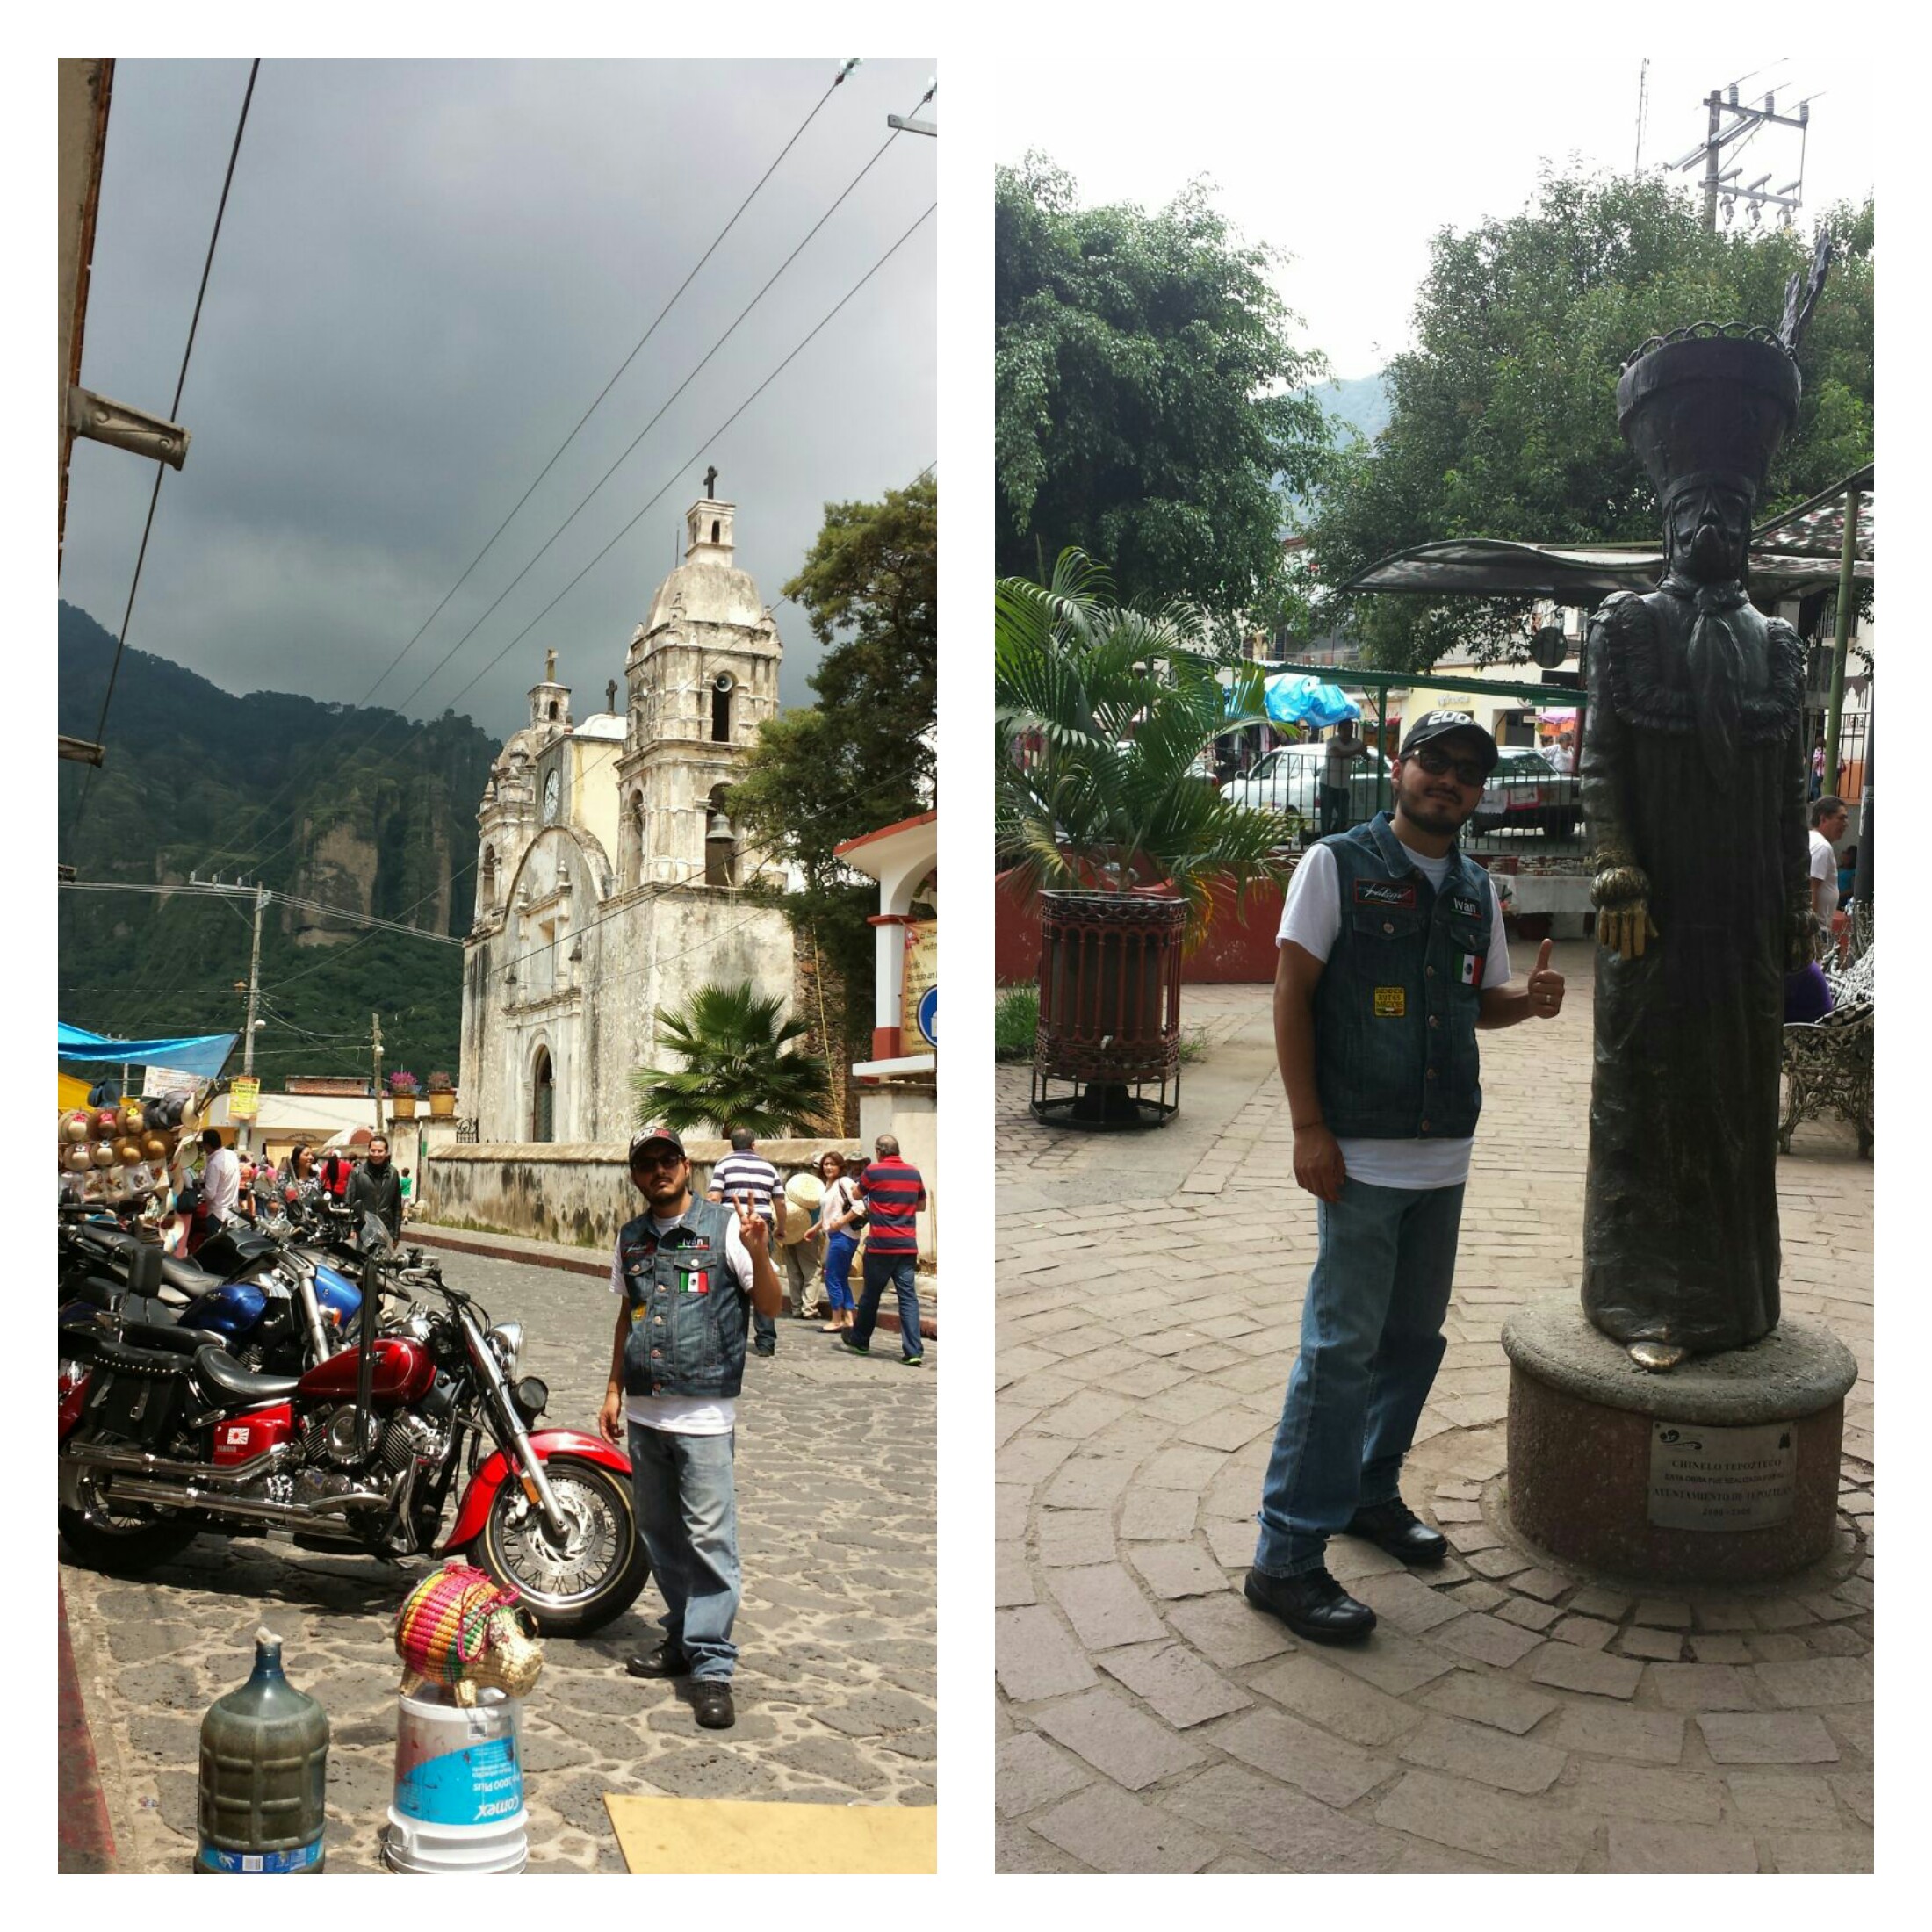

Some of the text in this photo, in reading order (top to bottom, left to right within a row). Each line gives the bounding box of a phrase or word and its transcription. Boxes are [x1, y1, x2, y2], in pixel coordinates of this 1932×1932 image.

[1672, 1459, 1782, 1471] CHINELO TEPOZTECO
[472, 1781, 493, 1792] Plus
[472, 1795, 519, 1821] Comex
